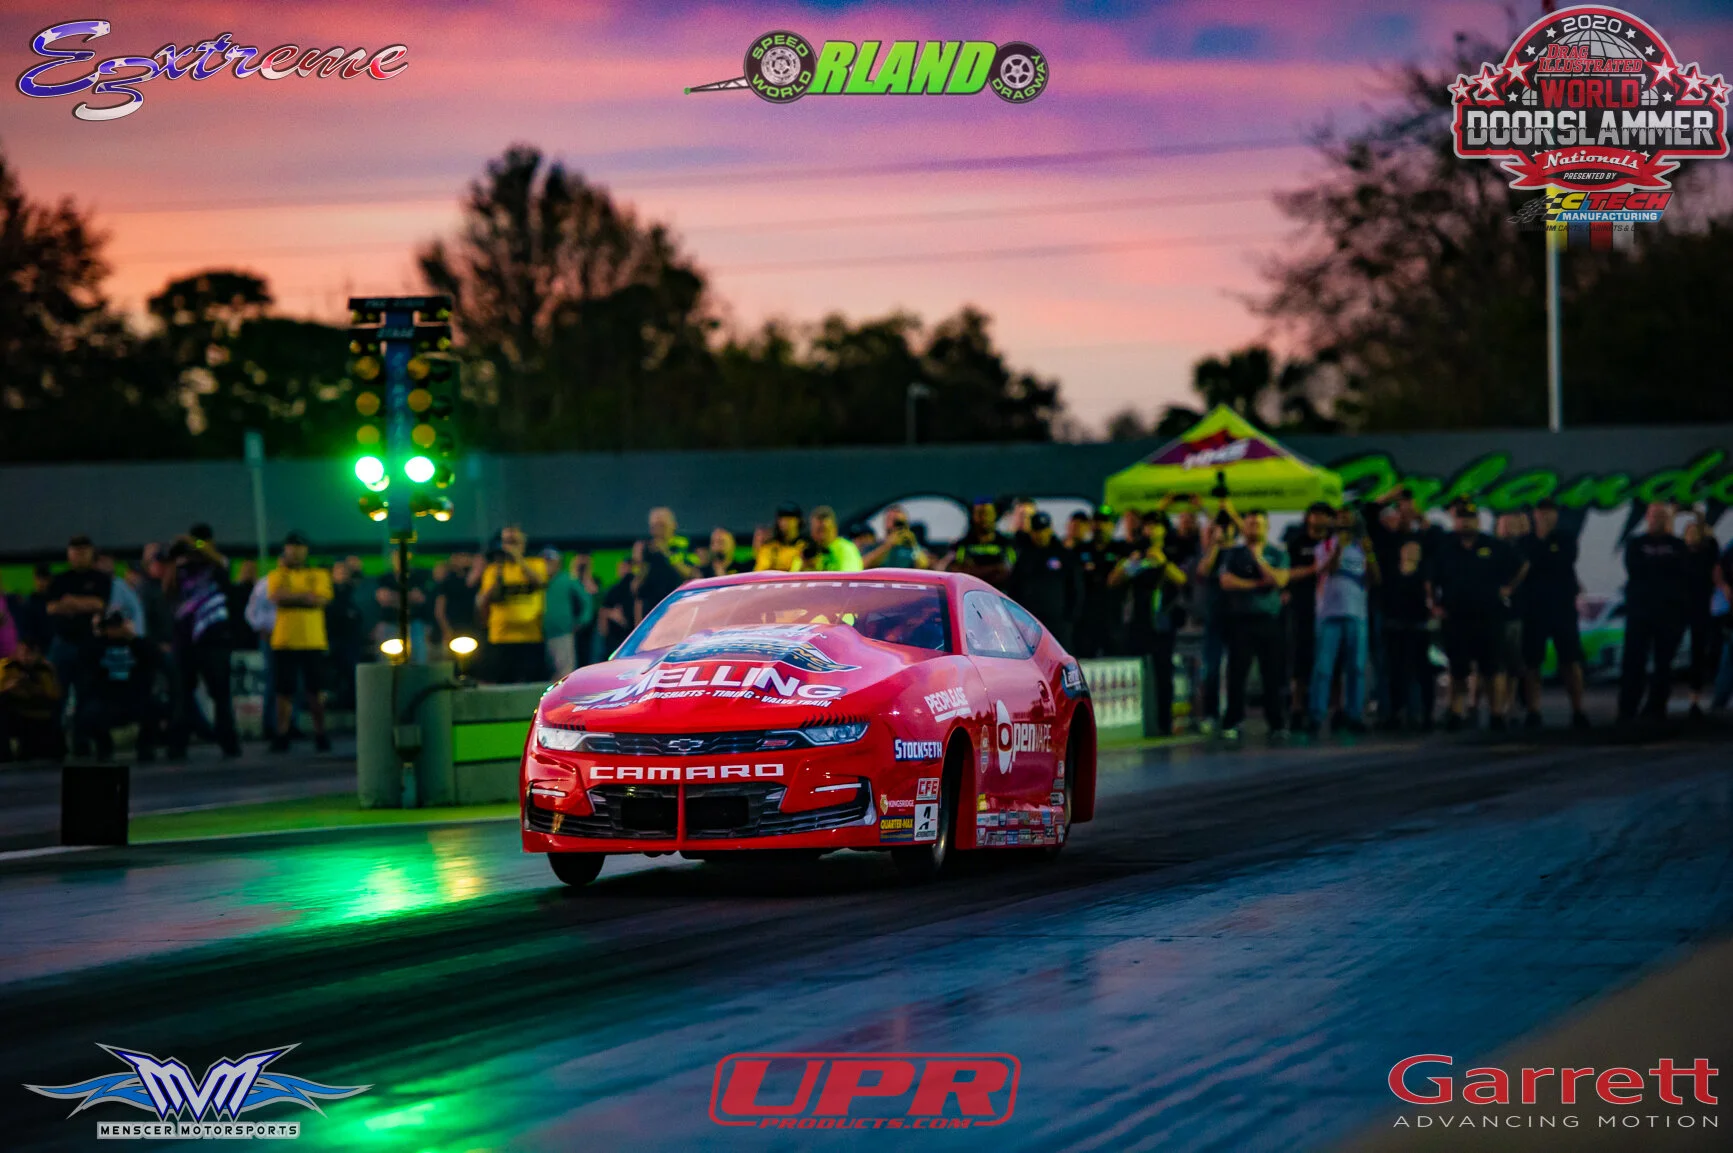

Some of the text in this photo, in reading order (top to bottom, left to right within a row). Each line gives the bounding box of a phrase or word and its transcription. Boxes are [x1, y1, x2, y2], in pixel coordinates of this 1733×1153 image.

[574, 665, 843, 704] MELLING
[641, 689, 704, 701] CAMSHAFTS
[712, 688, 753, 699] TIMING
[761, 695, 798, 706] VALVE
[797, 698, 833, 708] TRAIN
[589, 763, 785, 780] CAMARO
[918, 780, 938, 795] CFE
[880, 818, 913, 830] QUARTER-MAX
